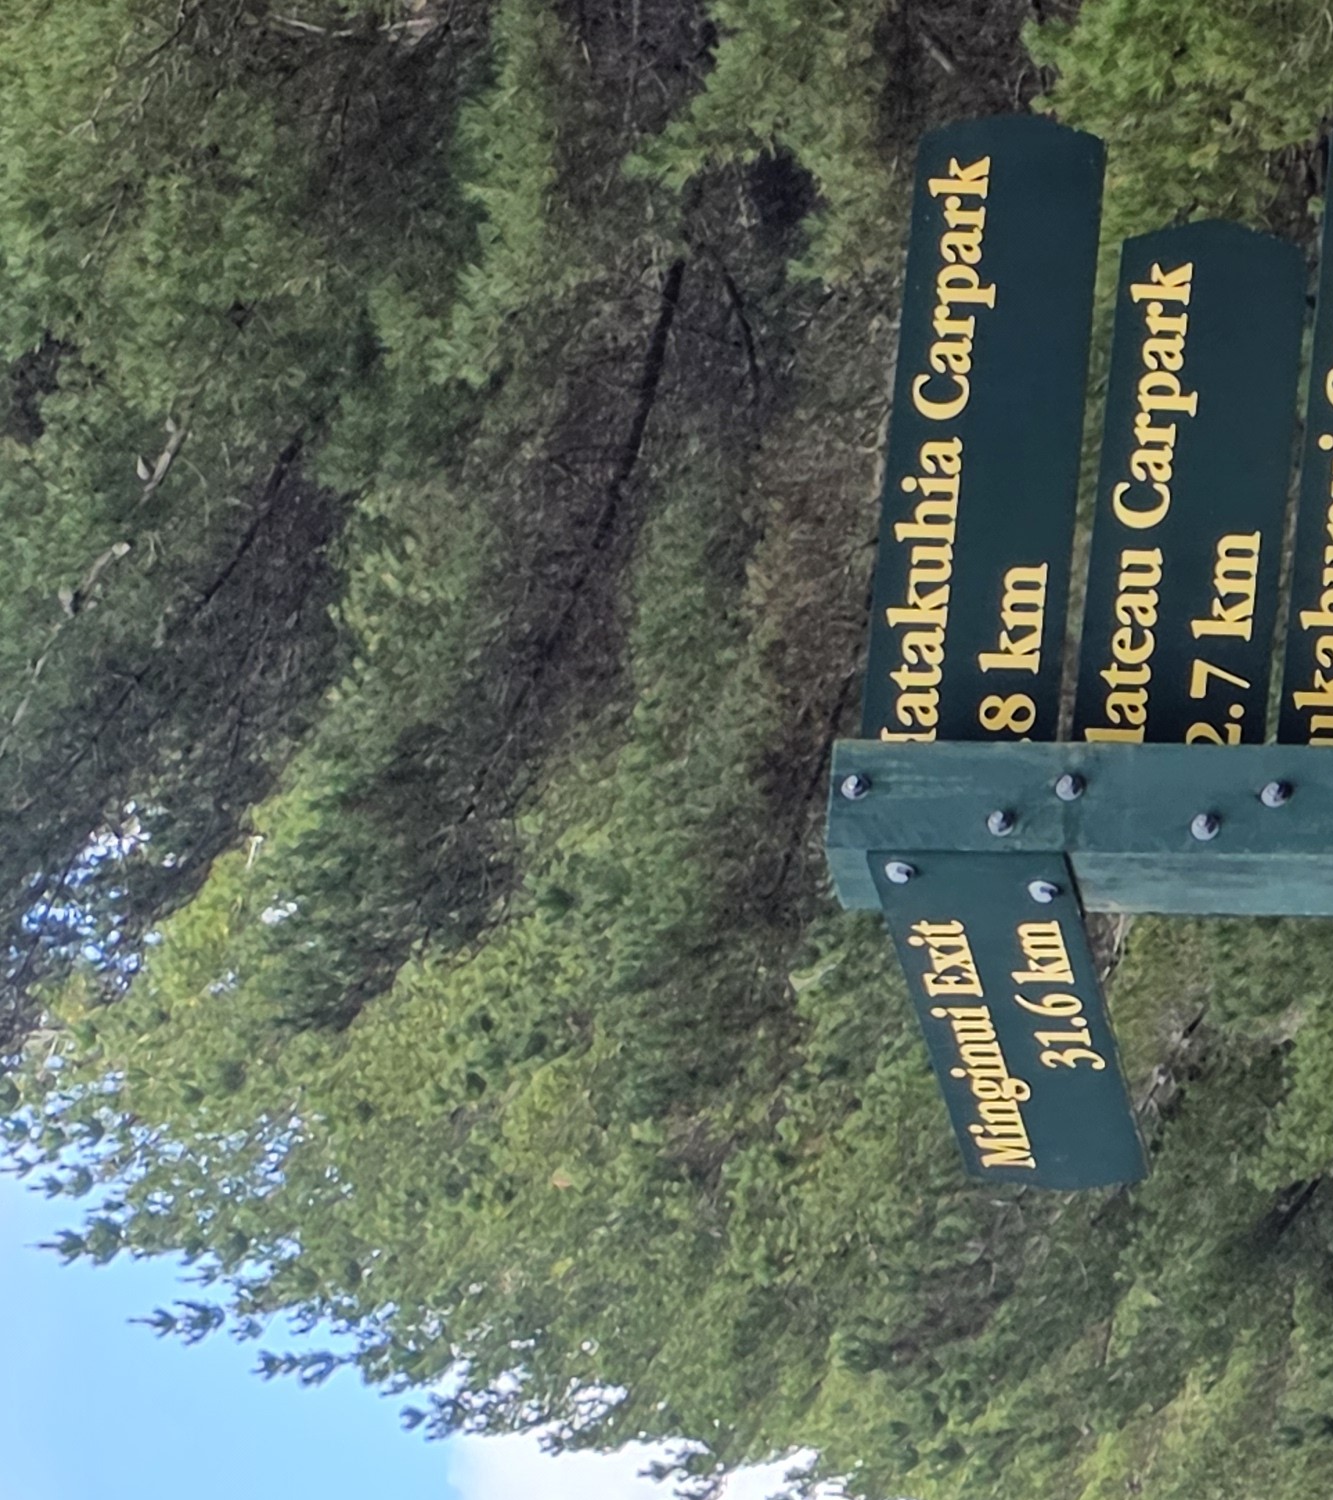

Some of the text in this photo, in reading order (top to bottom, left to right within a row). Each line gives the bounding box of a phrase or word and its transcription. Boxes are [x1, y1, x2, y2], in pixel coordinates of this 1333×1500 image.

[912, 156, 996, 421] Carpark
[1084, 263, 1198, 746] lateau Carpark
[1190, 532, 1261, 640] km
[978, 564, 1048, 672] km
[908, 920, 1033, 1167] Minginui Exit
[1013, 921, 1105, 1069] 31.6 km
